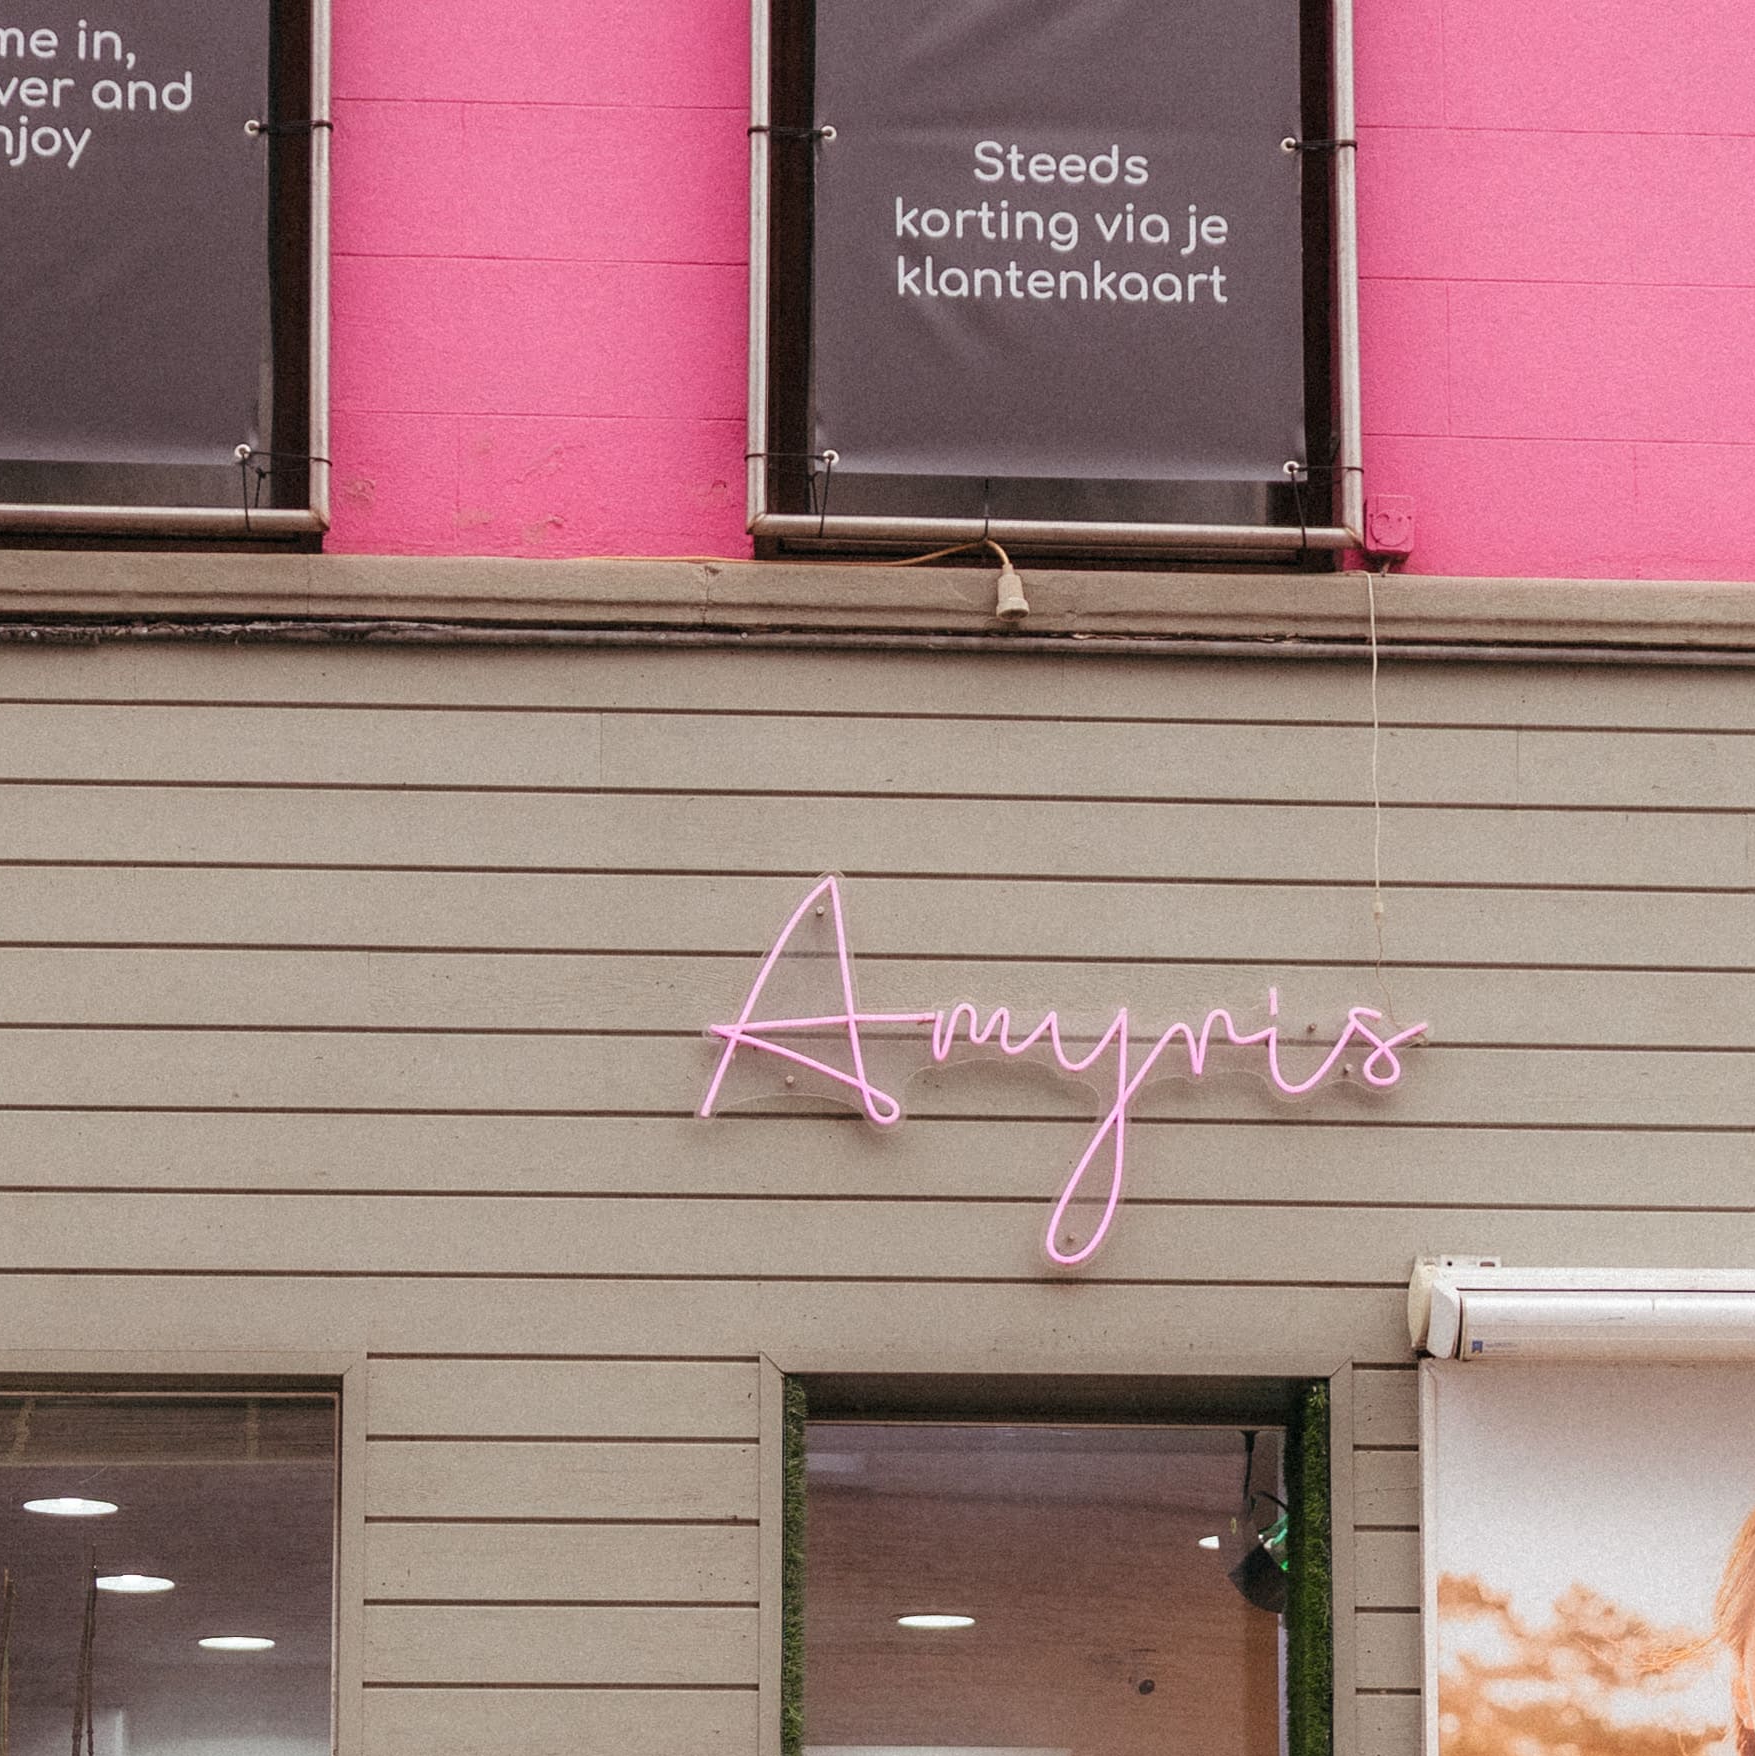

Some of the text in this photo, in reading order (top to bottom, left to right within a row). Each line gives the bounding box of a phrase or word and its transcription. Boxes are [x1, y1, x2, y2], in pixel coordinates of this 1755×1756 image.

[77, 19, 136, 70] in,
[91, 71, 193, 113] and
[973, 140, 1149, 186] Steeds
[895, 196, 1229, 256] korting via je
[897, 255, 1228, 304] klantenkaart
[700, 875, 1429, 1266] Amyris
